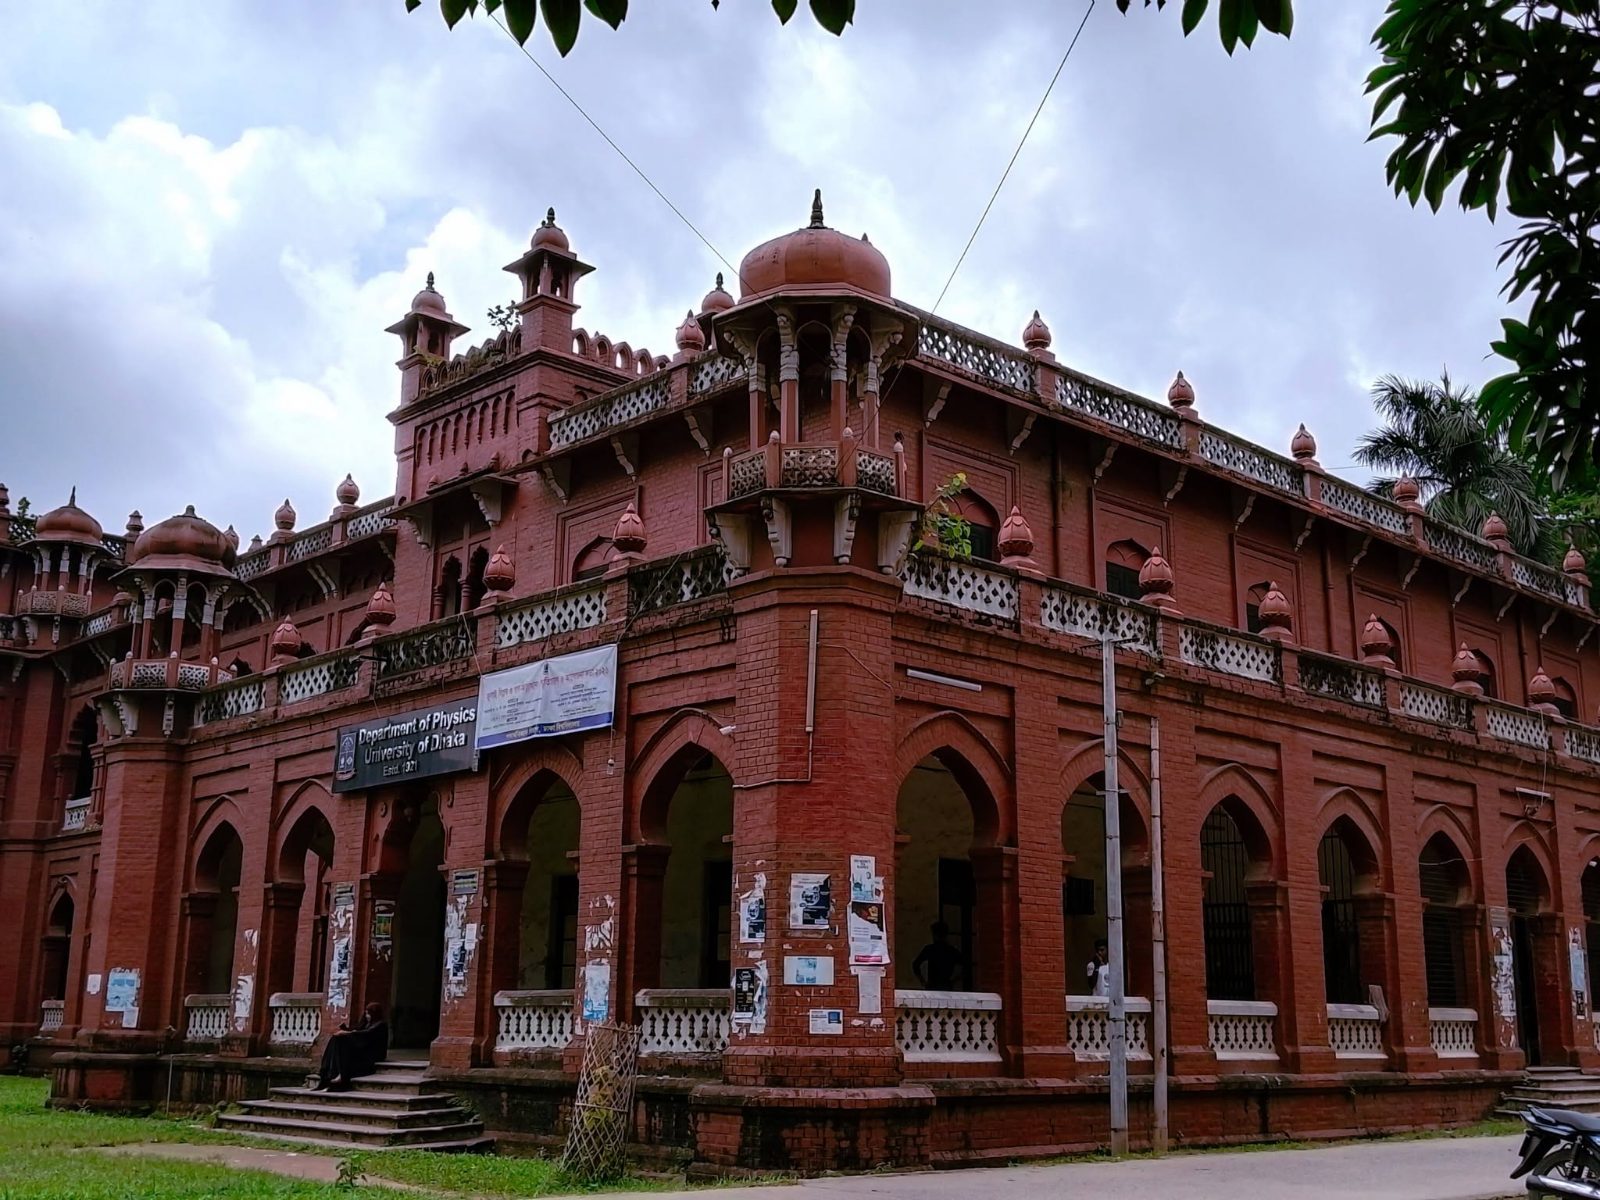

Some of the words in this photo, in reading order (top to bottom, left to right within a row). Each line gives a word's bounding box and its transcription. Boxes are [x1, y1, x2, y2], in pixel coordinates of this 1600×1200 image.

[359, 719, 417, 746] Department
[419, 713, 431, 731] of
[432, 707, 476, 732] Physics
[365, 742, 415, 764] University
[417, 736, 429, 754] of
[431, 730, 466, 752] Dhaka
[402, 761, 418, 773] 1921
